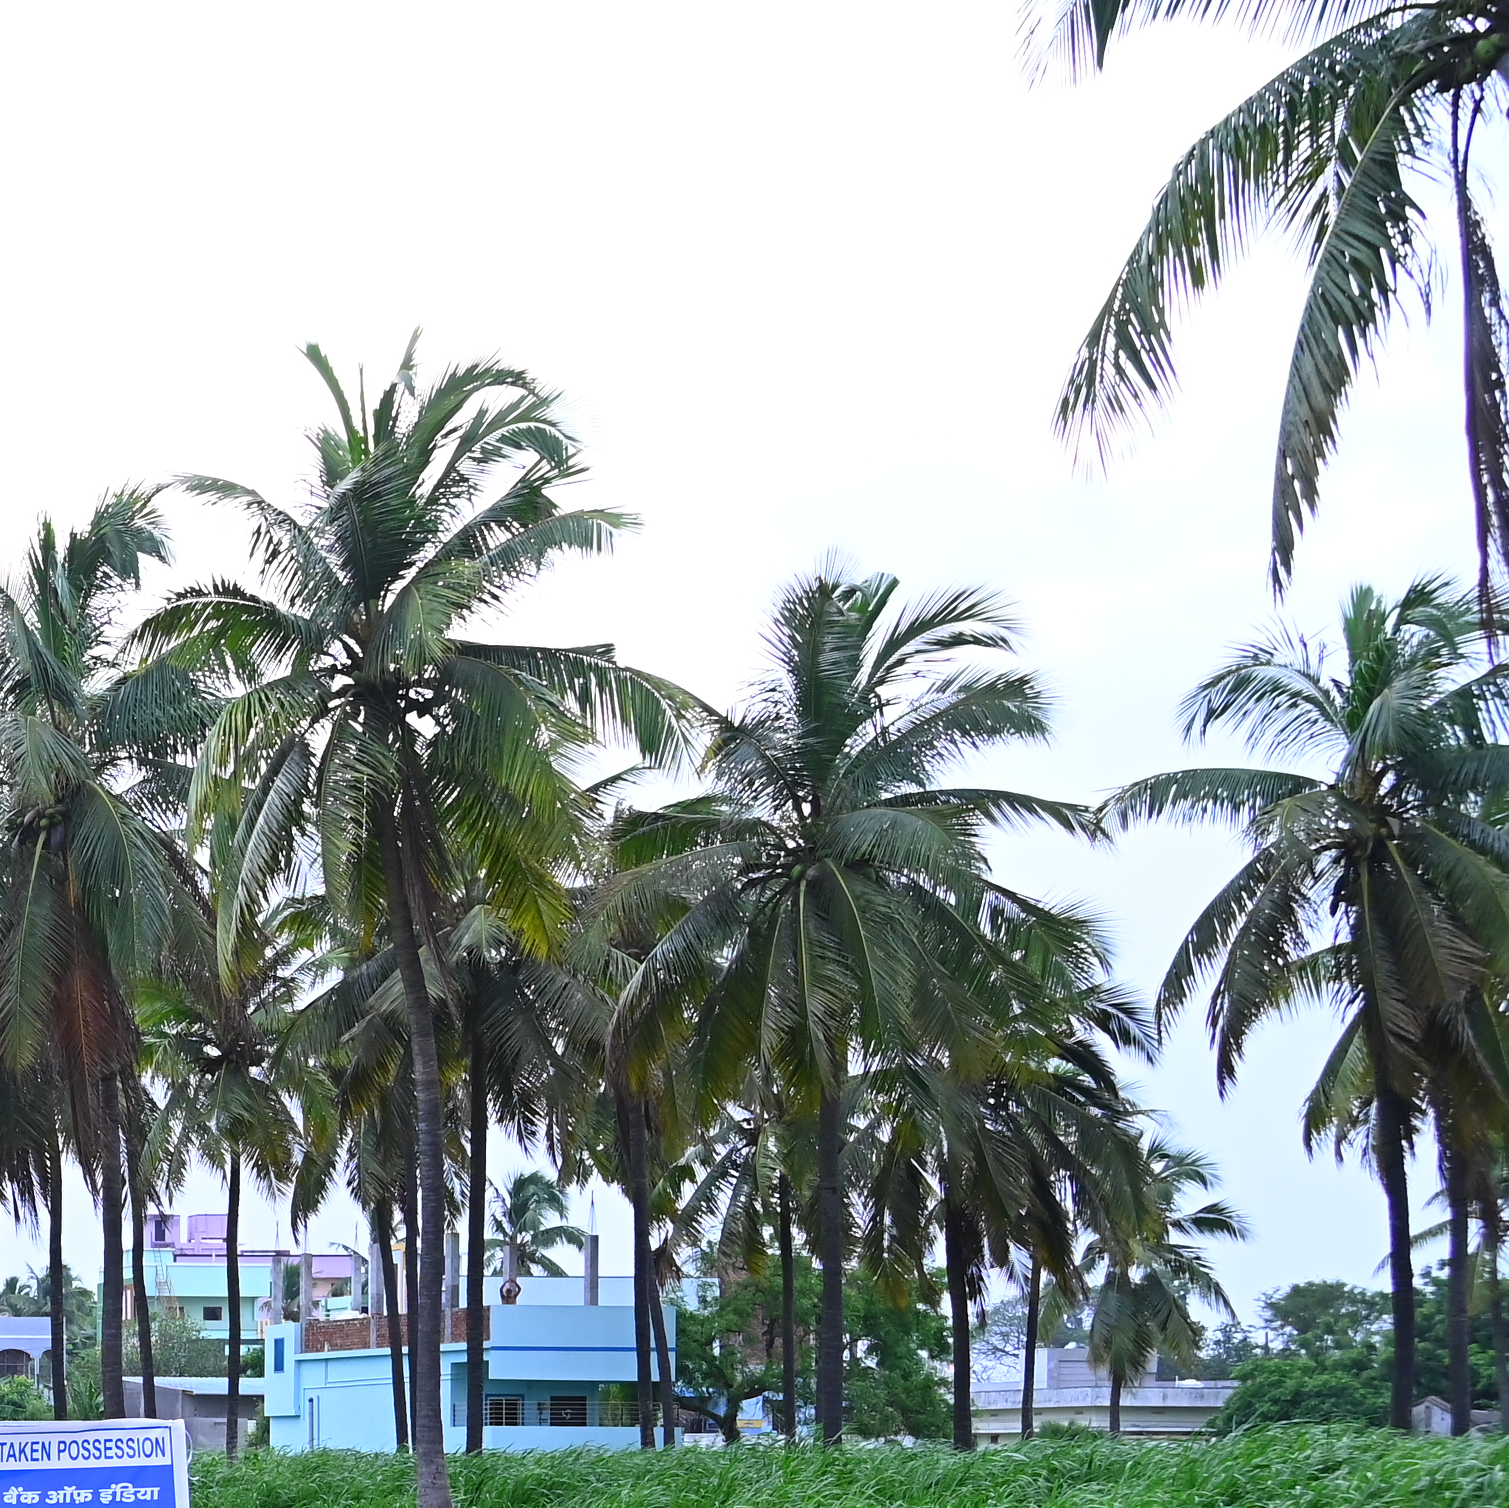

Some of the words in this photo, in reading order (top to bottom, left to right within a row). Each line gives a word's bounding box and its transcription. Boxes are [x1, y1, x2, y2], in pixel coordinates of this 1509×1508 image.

[57, 1436, 167, 1461] POSSESSION
[2, 1486, 42, 1505] बैंक
[98, 1482, 161, 1504] इंडिया
